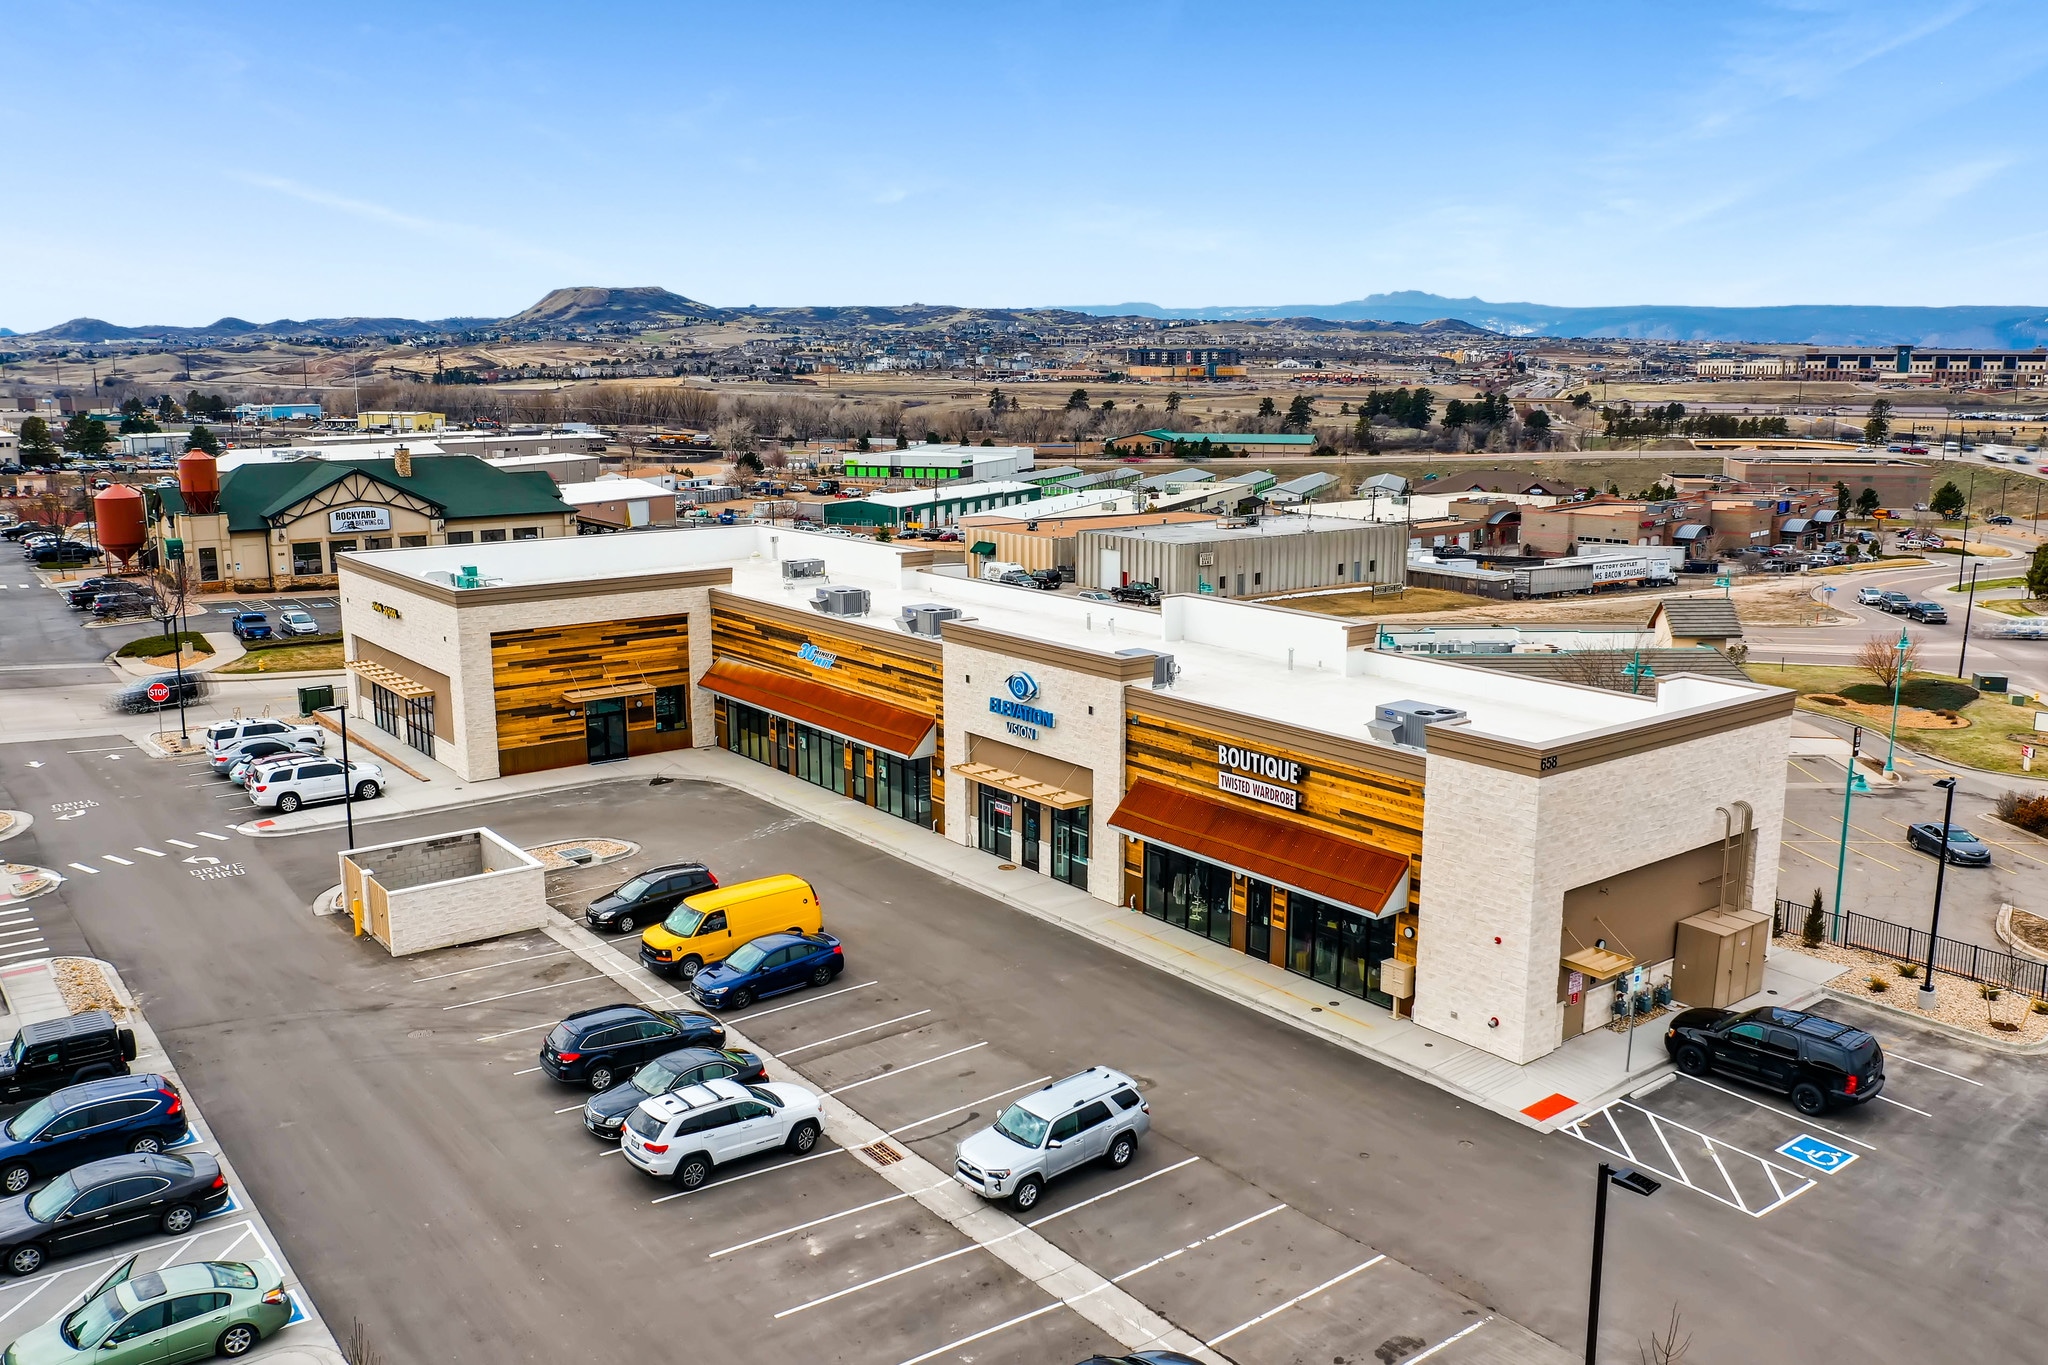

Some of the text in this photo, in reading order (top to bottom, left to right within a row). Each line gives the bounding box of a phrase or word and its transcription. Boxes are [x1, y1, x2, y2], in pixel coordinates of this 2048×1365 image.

[335, 510, 376, 521] ROCKYARD
[355, 519, 377, 527] BREWING
[1604, 570, 1621, 579] BACON
[1623, 568, 1646, 577] SAUSAGE
[797, 642, 837, 661] 30 MINUTE
[813, 656, 835, 670] HIT
[149, 688, 168, 697] STOP
[989, 696, 1056, 729] ELEVATION
[1006, 721, 1038, 741] VISION
[1218, 744, 1299, 785] BOUTIQUE
[1541, 755, 1557, 771] 658
[1220, 774, 1294, 806] TWISTED WARDROBE
[189, 862, 246, 876] DRIVE
[195, 869, 247, 881] THRU
